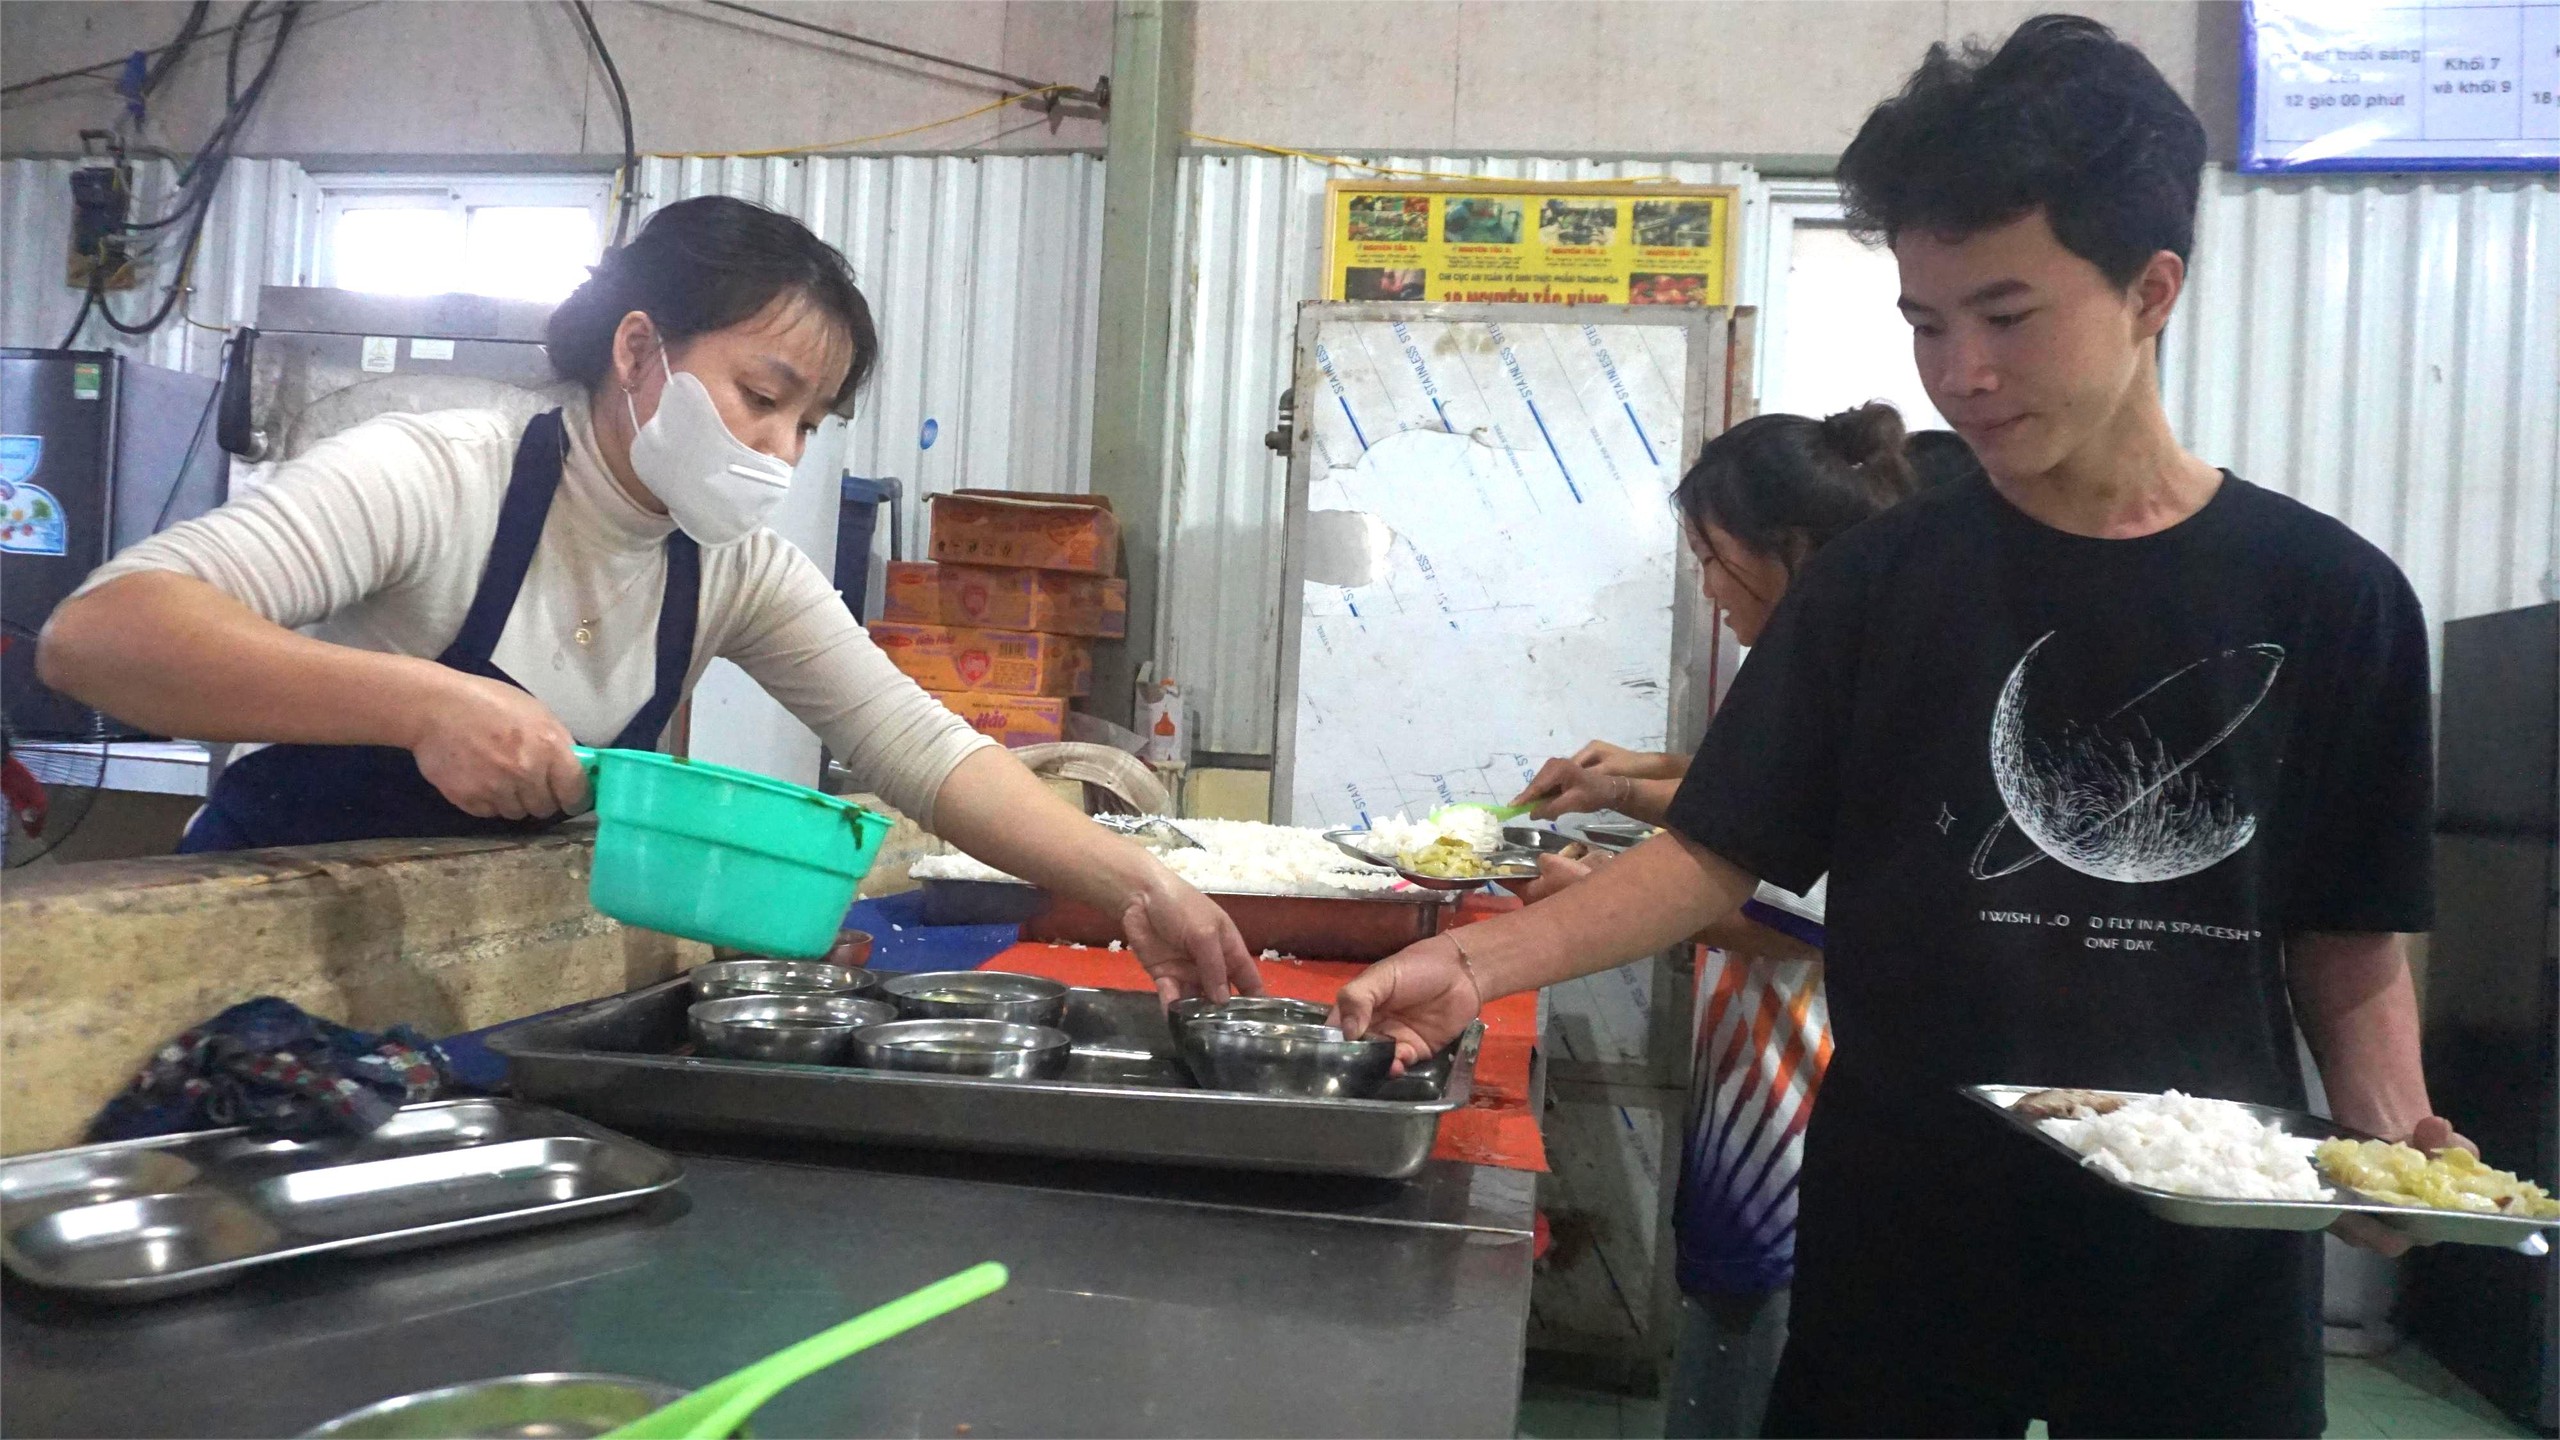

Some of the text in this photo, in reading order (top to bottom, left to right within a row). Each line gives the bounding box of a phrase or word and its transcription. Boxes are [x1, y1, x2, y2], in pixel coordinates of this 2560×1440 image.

[2491, 57, 2501, 70] 7
[2501, 80, 2512, 93] 9
[1315, 344, 1345, 395] STAINLESS
[1393, 320, 1438, 396] STAINLESS STEE
[1486, 321, 1533, 399] STAINLESS STEE
[1582, 322, 1629, 401] STAINLESS STEE
[1979, 910, 1986, 921] I
[1987, 911, 2032, 924] WISH
[2034, 914, 2041, 925] I
[2107, 917, 2135, 930] FLY
[2138, 919, 2154, 931] IN
[2155, 920, 2167, 932] A
[2170, 920, 2263, 942] SPACESH
